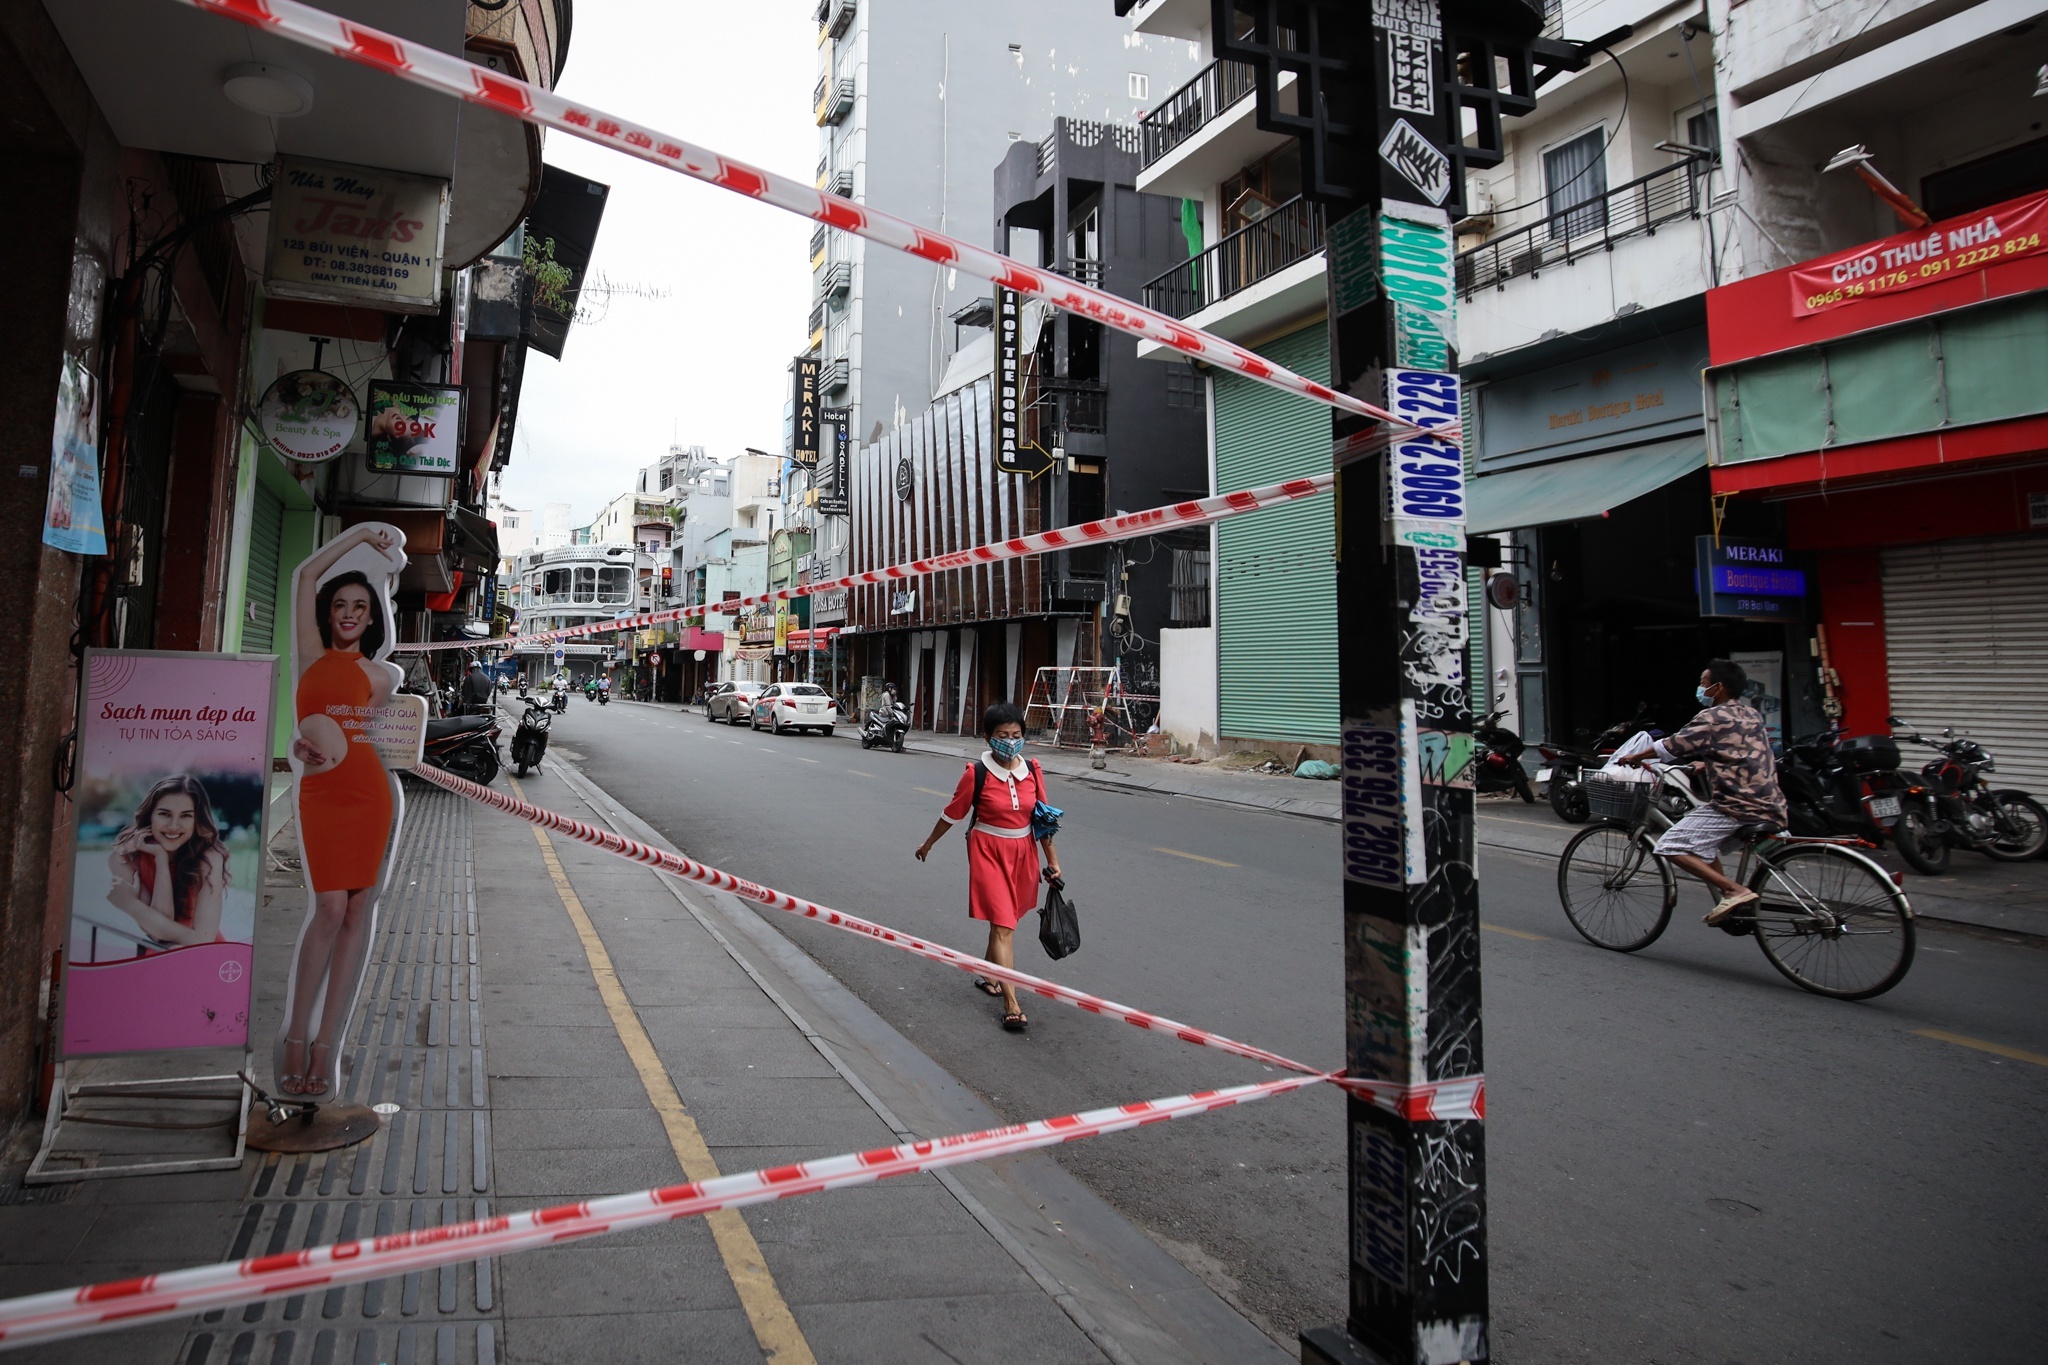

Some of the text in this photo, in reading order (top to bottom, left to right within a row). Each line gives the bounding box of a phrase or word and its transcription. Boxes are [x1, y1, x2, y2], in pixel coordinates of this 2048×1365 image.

[1372, 14, 1442, 40] SLUTS CRUE
[1412, 39, 1428, 110] OVERT
[289, 170, 376, 199] Nhà May
[282, 239, 305, 250] 125
[309, 239, 332, 254] BÙI
[338, 244, 369, 259] VIỆN
[382, 251, 421, 267] QUẬN
[425, 258, 430, 267] 1
[1832, 215, 2003, 285] CHO THUÊ NHÀ
[303, 256, 409, 279] ĐT: 08.38368169
[311, 272, 338, 283] (MAY
[341, 275, 370, 286] TRÊN
[1805, 288, 1843, 310] 0966
[1846, 282, 1865, 298] 36
[1869, 270, 1908, 292] 1176
[1921, 262, 1951, 279] 091
[1957, 245, 2001, 269] 2222
[2004, 233, 2040, 254] 824
[1003, 320, 1016, 342] OF
[1003, 347, 1017, 382] THE
[801, 362, 816, 447] MERAKI
[825, 412, 846, 421] Hotel
[1002, 386, 1016, 423] DOG
[1549, 388, 1664, 430] Meraki Boutique Hotel
[275, 423, 341, 439] Beauty & Spa
[272, 436, 296, 456] Hotline:
[796, 449, 818, 463] HOTEL
[1002, 427, 1016, 463] BAR
[1726, 546, 1783, 563] MERAKI
[1727, 570, 1769, 591] Boutique
[1737, 600, 1749, 610] 178
[101, 702, 256, 726] Sạch mụn đẹp da
[376, 706, 396, 718] HIỆU
[120, 728, 136, 742] TỰ
[140, 728, 159, 740] TIN
[196, 727, 237, 741] SÁNG
[1343, 729, 1400, 884] 0982.756.333
